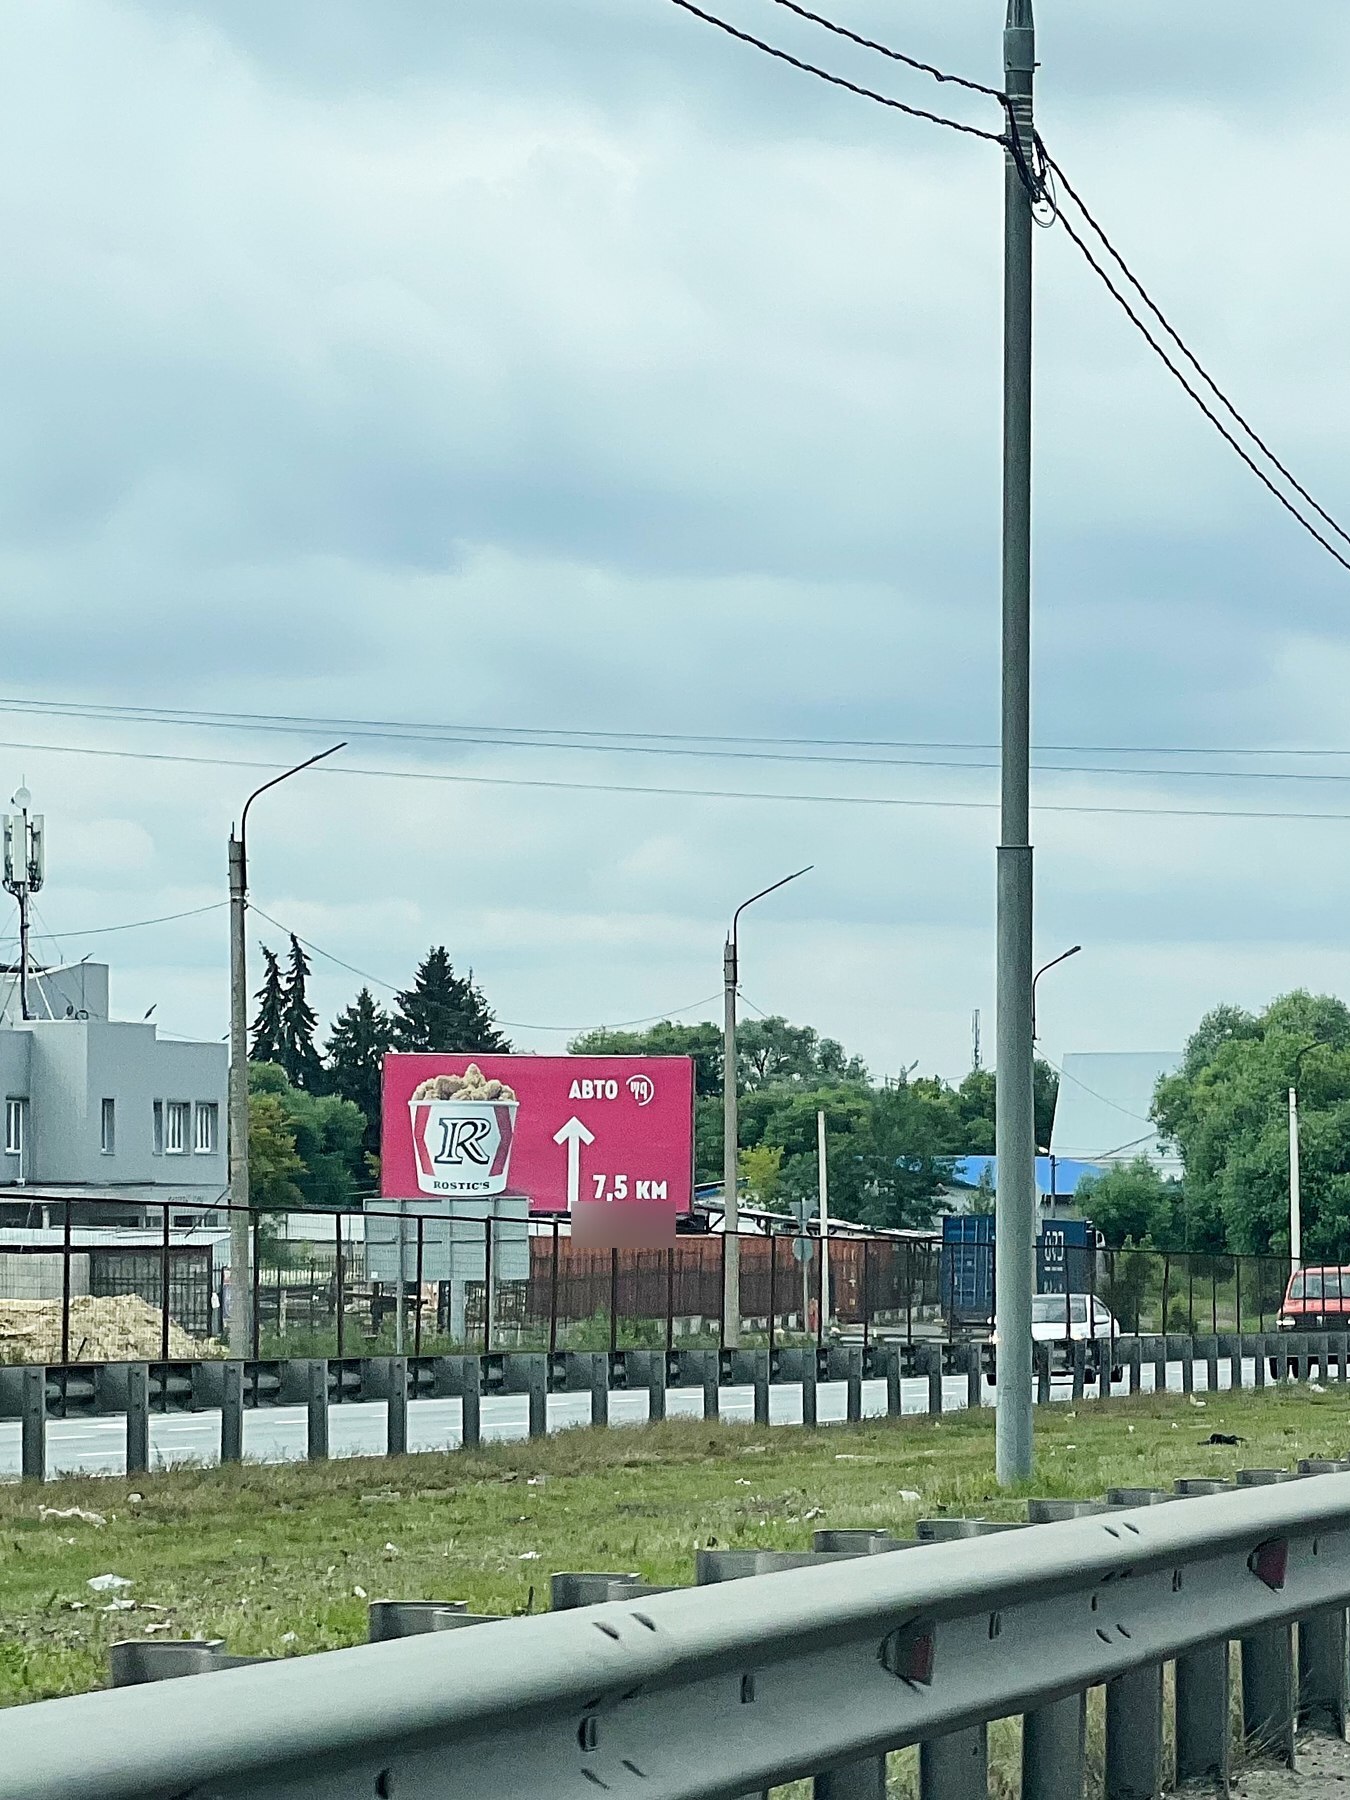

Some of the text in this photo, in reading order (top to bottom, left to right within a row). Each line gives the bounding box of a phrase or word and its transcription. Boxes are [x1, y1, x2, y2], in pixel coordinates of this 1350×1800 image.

[568, 1079, 619, 1100] АВТО
[434, 1117, 492, 1165] R
[433, 1181, 490, 1191] ROSTIC'S
[592, 1174, 628, 1202] 7,5
